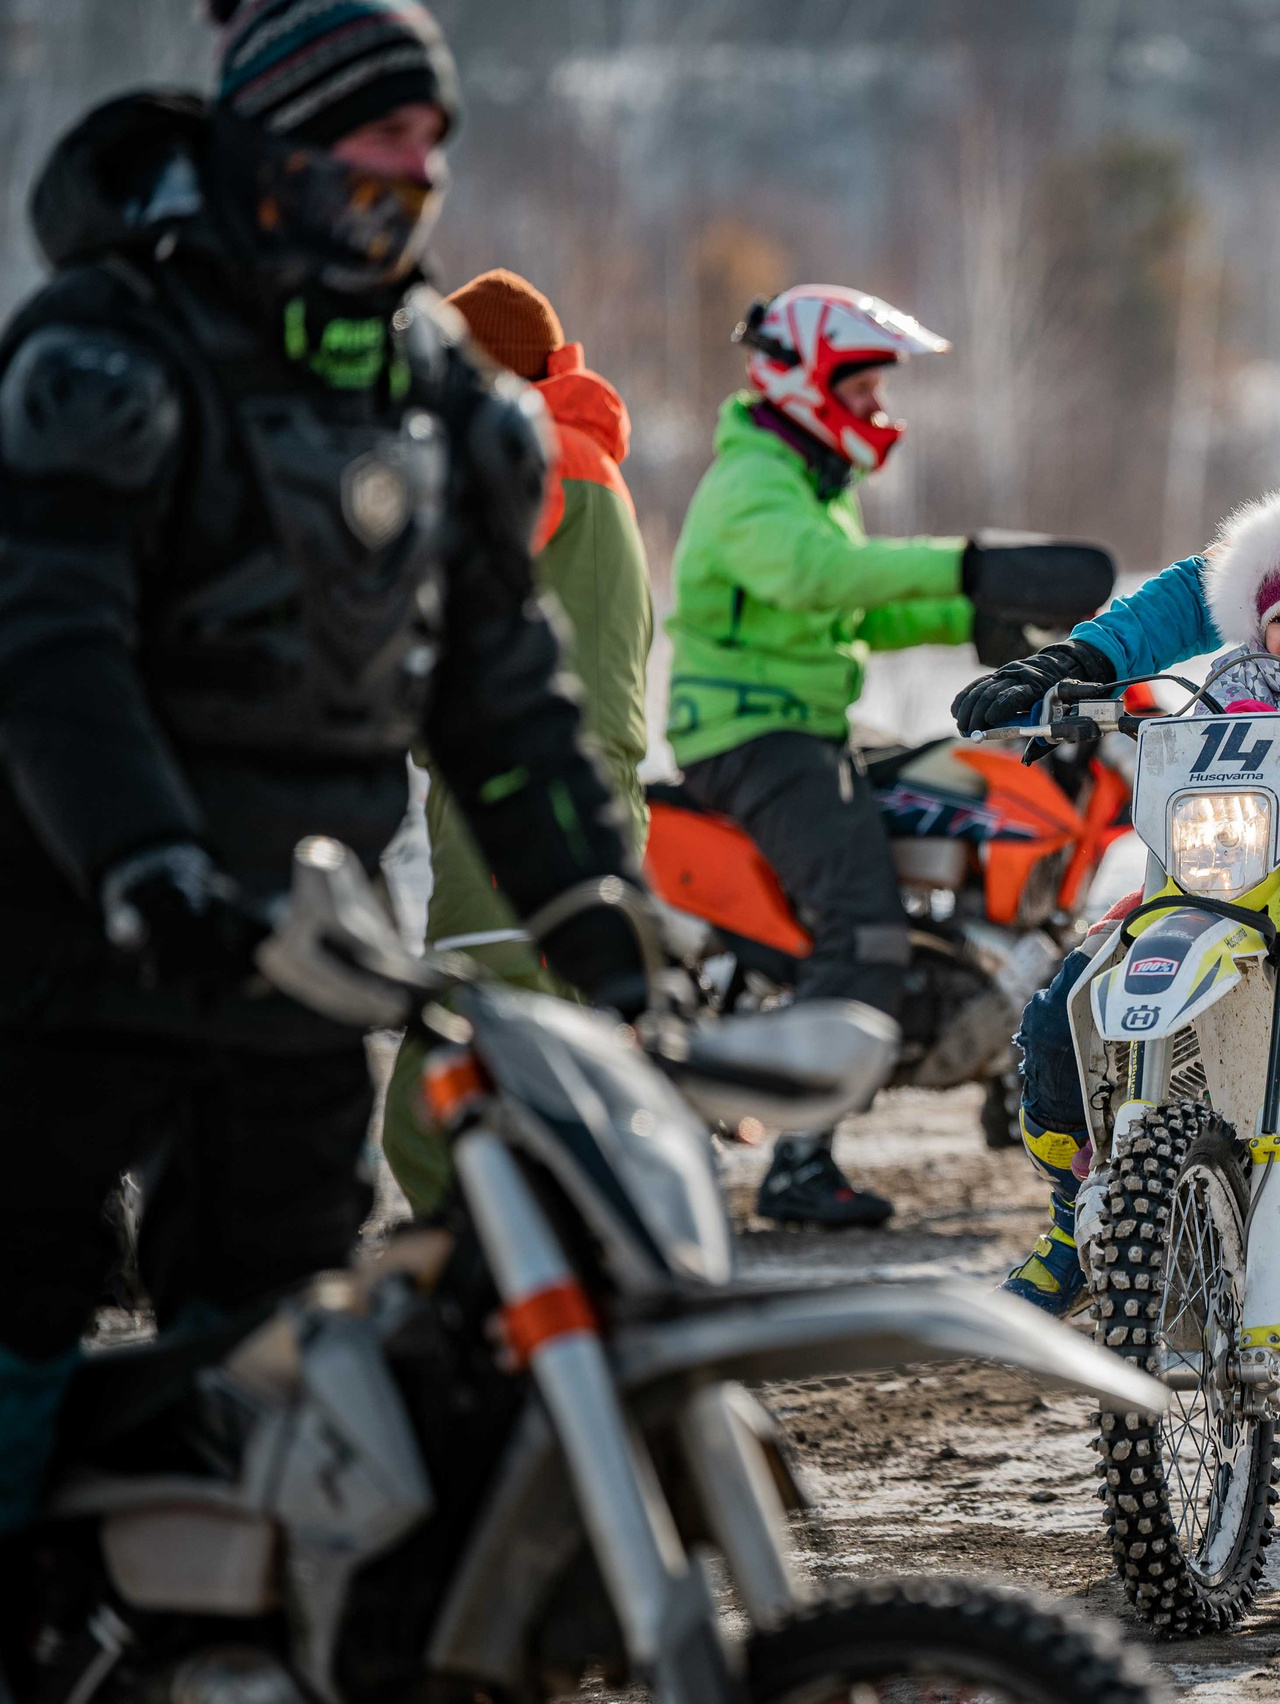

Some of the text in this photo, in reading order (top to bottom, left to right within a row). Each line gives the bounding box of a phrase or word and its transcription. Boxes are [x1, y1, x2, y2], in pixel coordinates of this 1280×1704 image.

[1189, 722, 1274, 773] 14
[1189, 772, 1264, 782] Husqvarna
[1136, 961, 1171, 973] 100%
